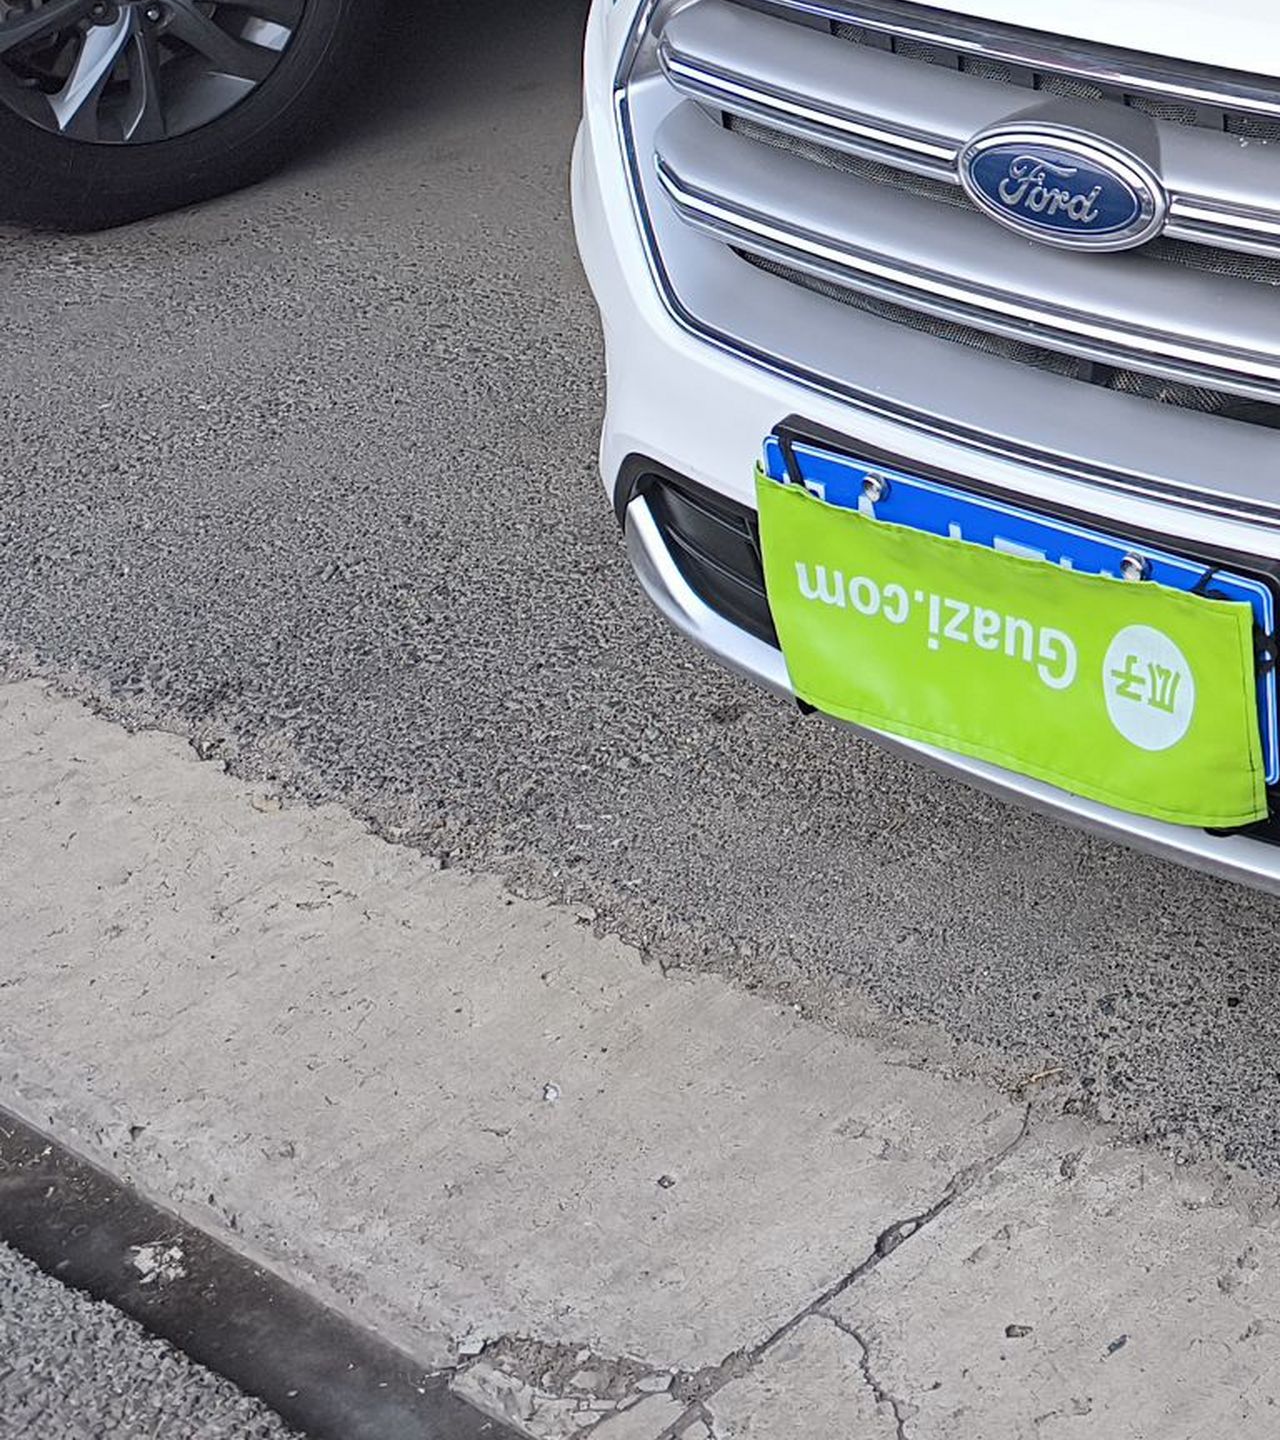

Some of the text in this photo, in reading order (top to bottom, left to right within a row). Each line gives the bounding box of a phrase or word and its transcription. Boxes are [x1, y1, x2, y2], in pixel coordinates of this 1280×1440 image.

[998, 155, 1101, 223] Ford
[795, 560, 1077, 691] Guazi.com
[1110, 655, 1181, 714] 瓜子
